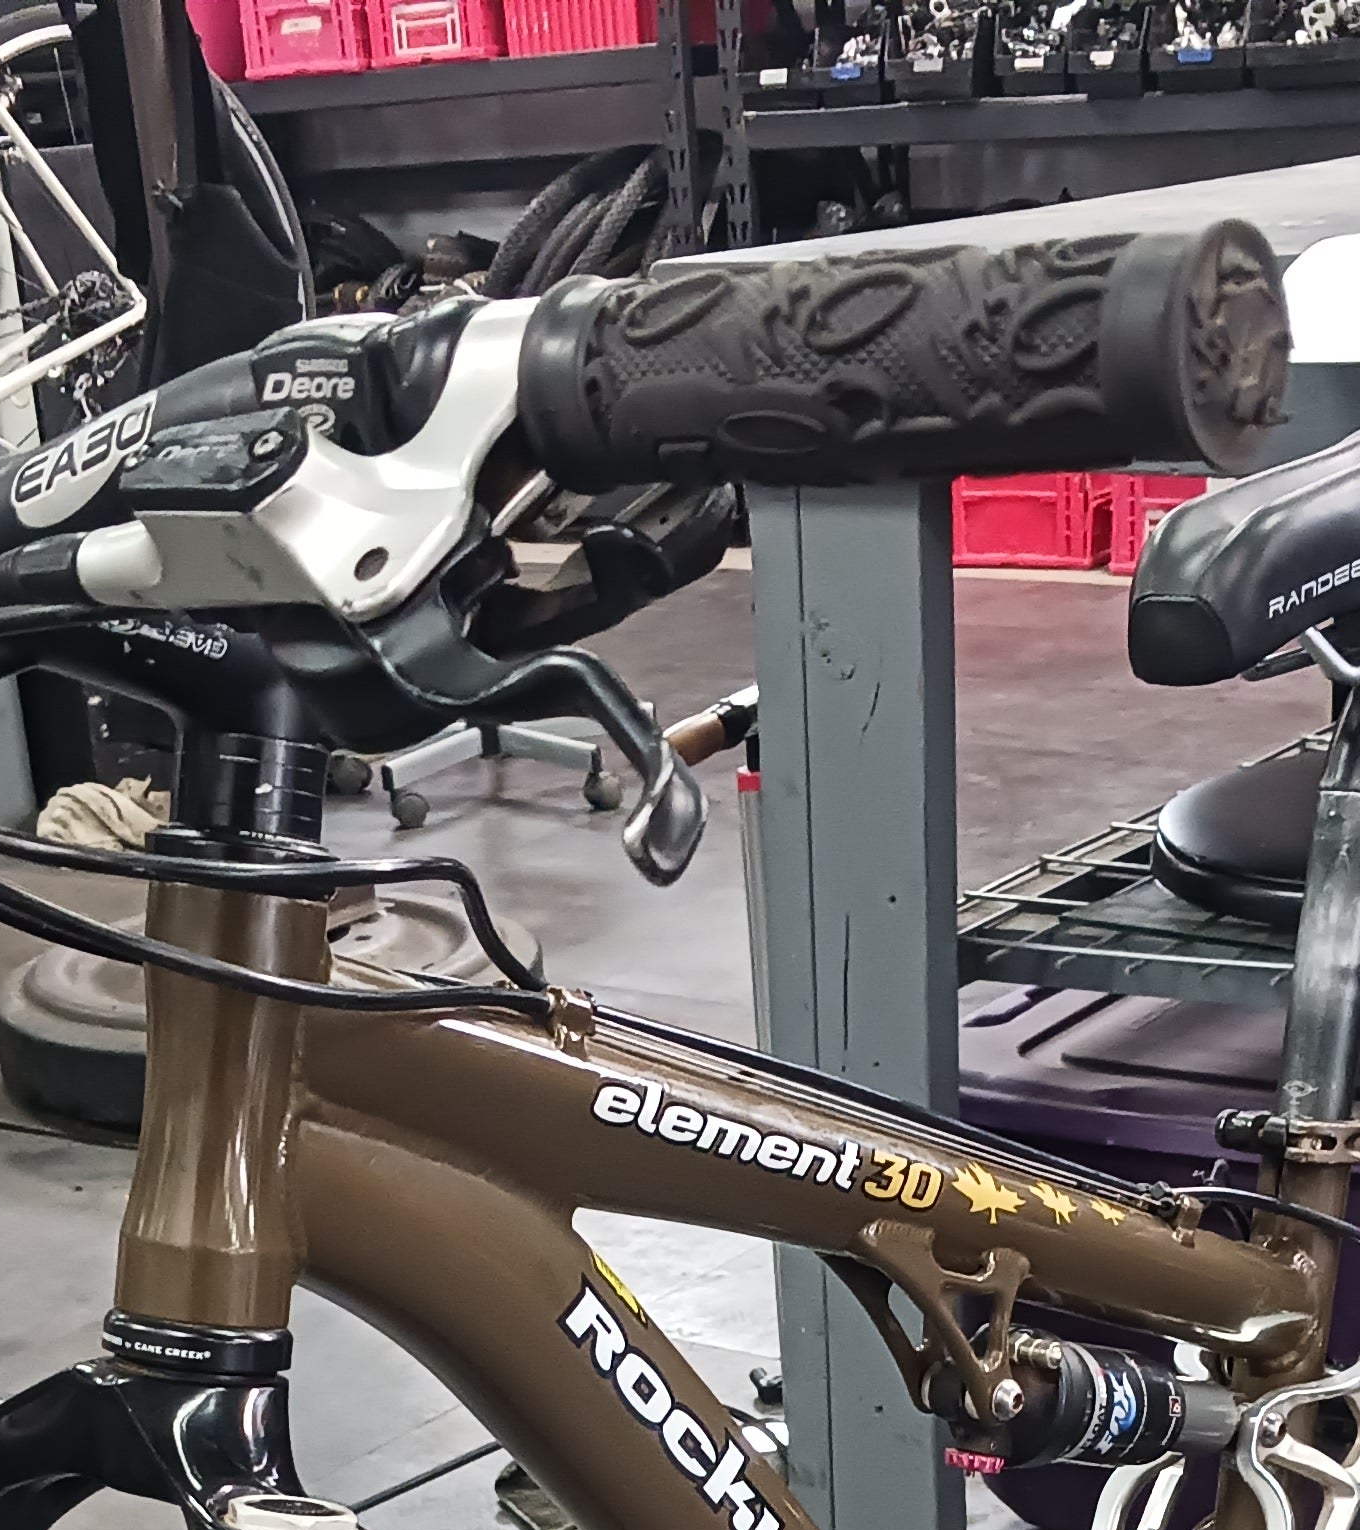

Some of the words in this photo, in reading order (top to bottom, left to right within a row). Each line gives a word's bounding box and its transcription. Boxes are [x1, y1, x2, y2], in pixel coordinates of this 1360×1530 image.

[262, 371, 356, 402] Deore
[593, 1080, 863, 1193] element
[863, 1149, 942, 1211] 30
[134, 1341, 163, 1355] CANE
